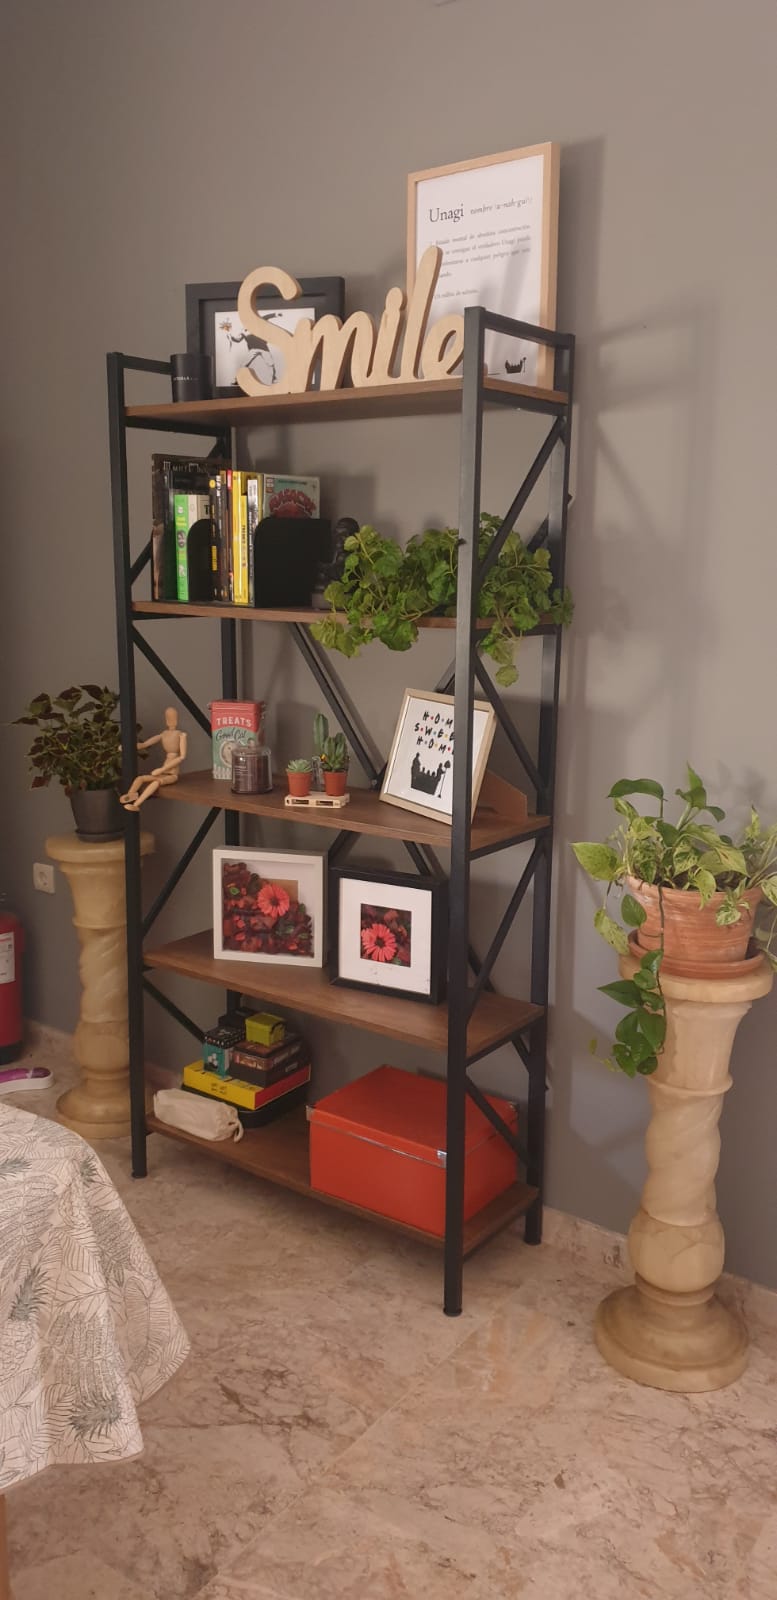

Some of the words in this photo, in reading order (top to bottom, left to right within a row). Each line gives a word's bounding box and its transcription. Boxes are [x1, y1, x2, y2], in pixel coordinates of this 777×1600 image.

[429, 203, 464, 223] Unagi
[236, 245, 465, 397] Smile
[216, 717, 252, 727] TREATS
